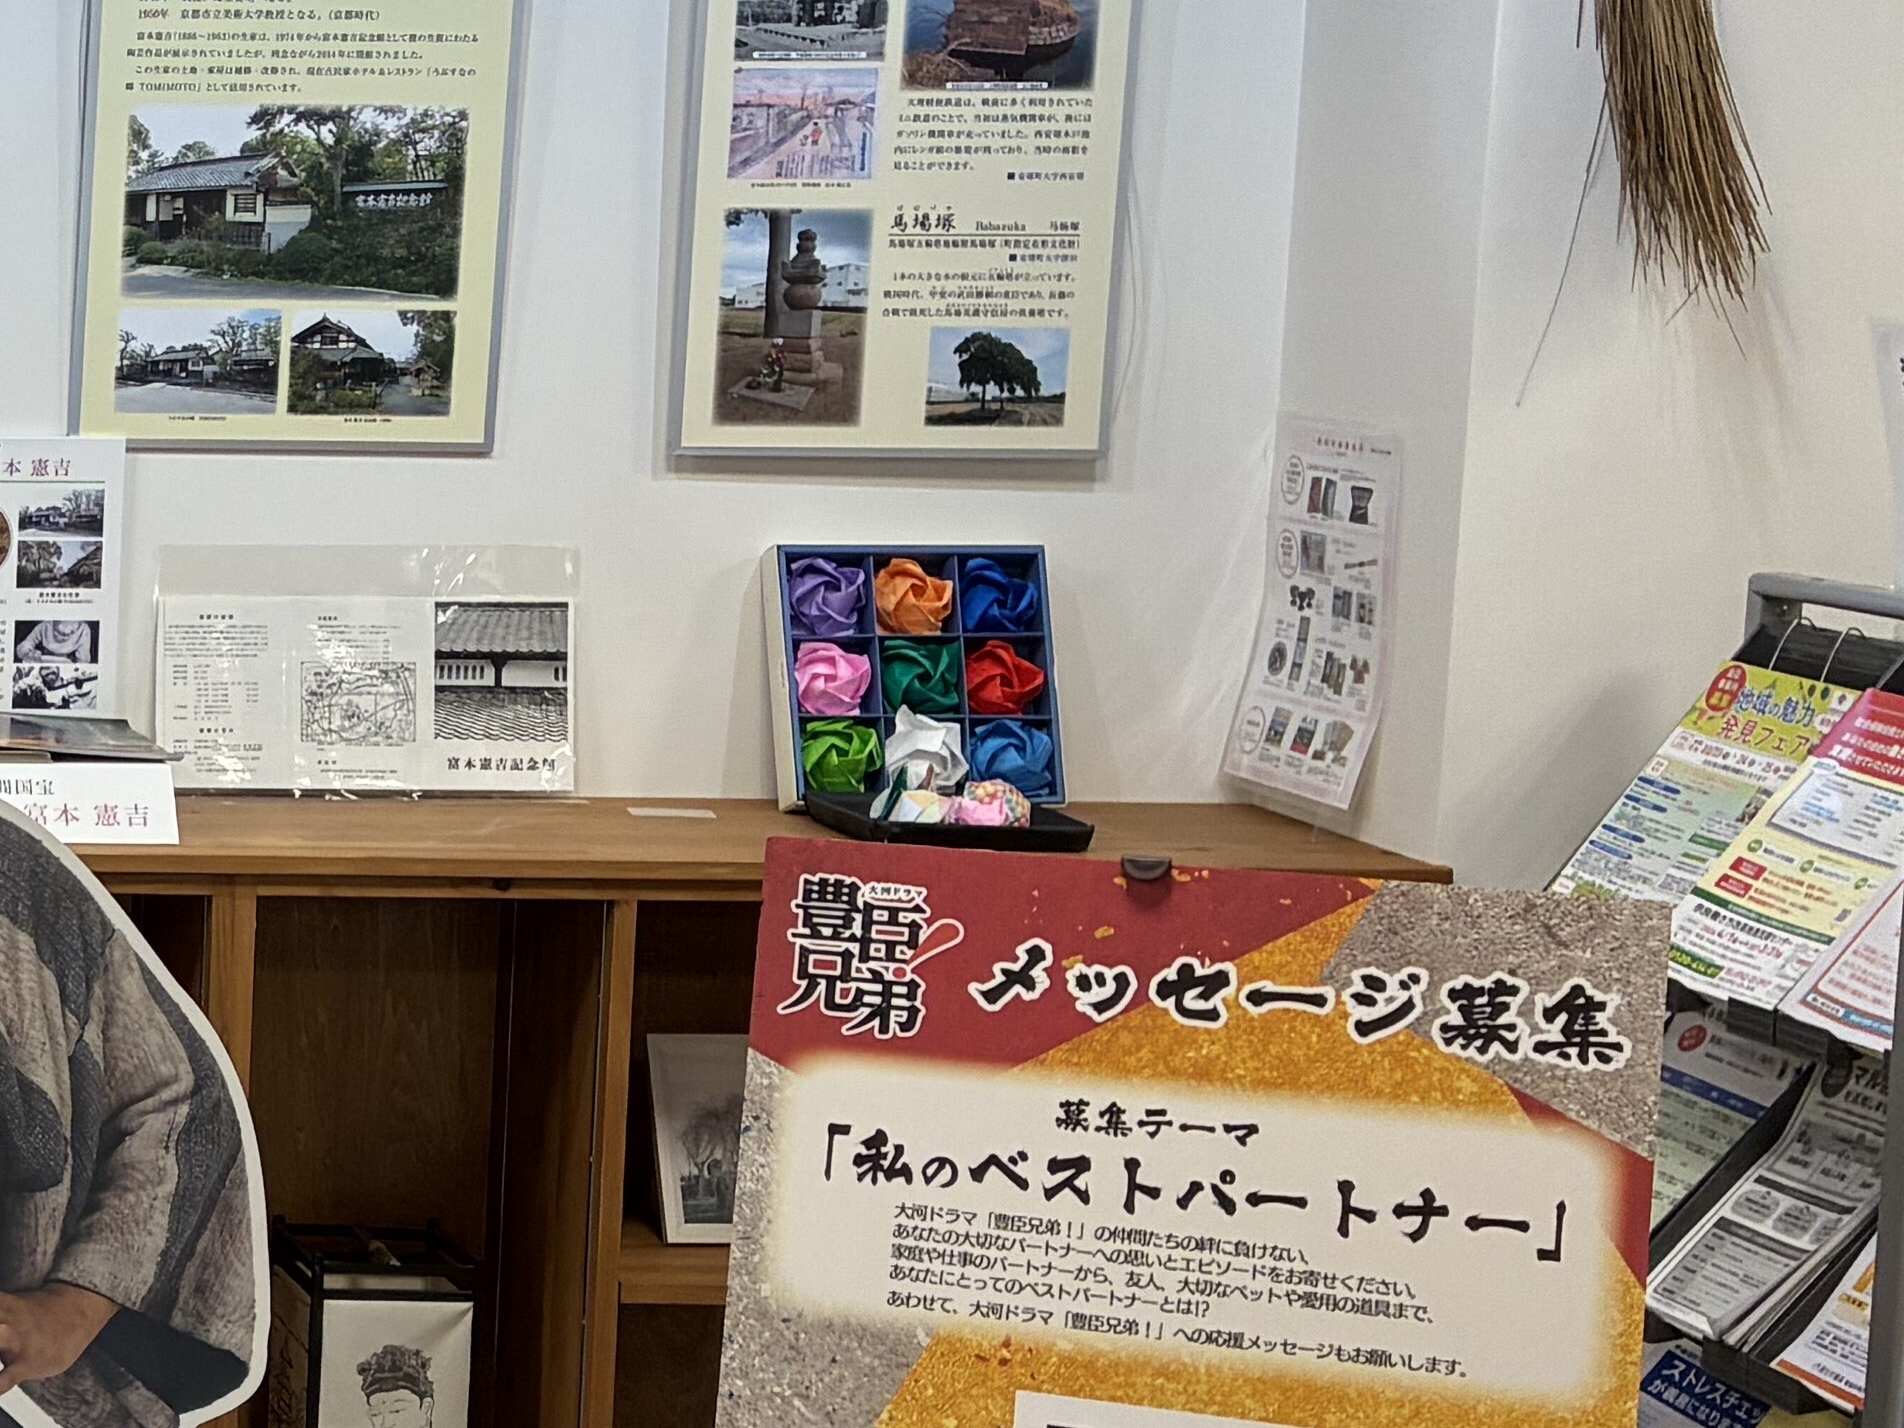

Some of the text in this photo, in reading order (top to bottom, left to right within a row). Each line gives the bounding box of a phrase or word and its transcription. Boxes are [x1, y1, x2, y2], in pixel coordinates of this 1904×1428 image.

[891, 213, 956, 232] 馬場塚
[31, 459, 70, 476] 憲吉
[1736, 686, 1816, 727] 地域の魅力
[1717, 714, 1809, 756] 発見フェア
[446, 757, 557, 772] 富本憲吉記念館
[93, 802, 150, 828] 憲吉
[869, 884, 923, 898] 大河ドラマ
[971, 942, 1629, 1070] メッセージ募集
[1054, 1099, 1259, 1145] 募集テーマ
[824, 1122, 1565, 1263] 「私のベストパートナー」
